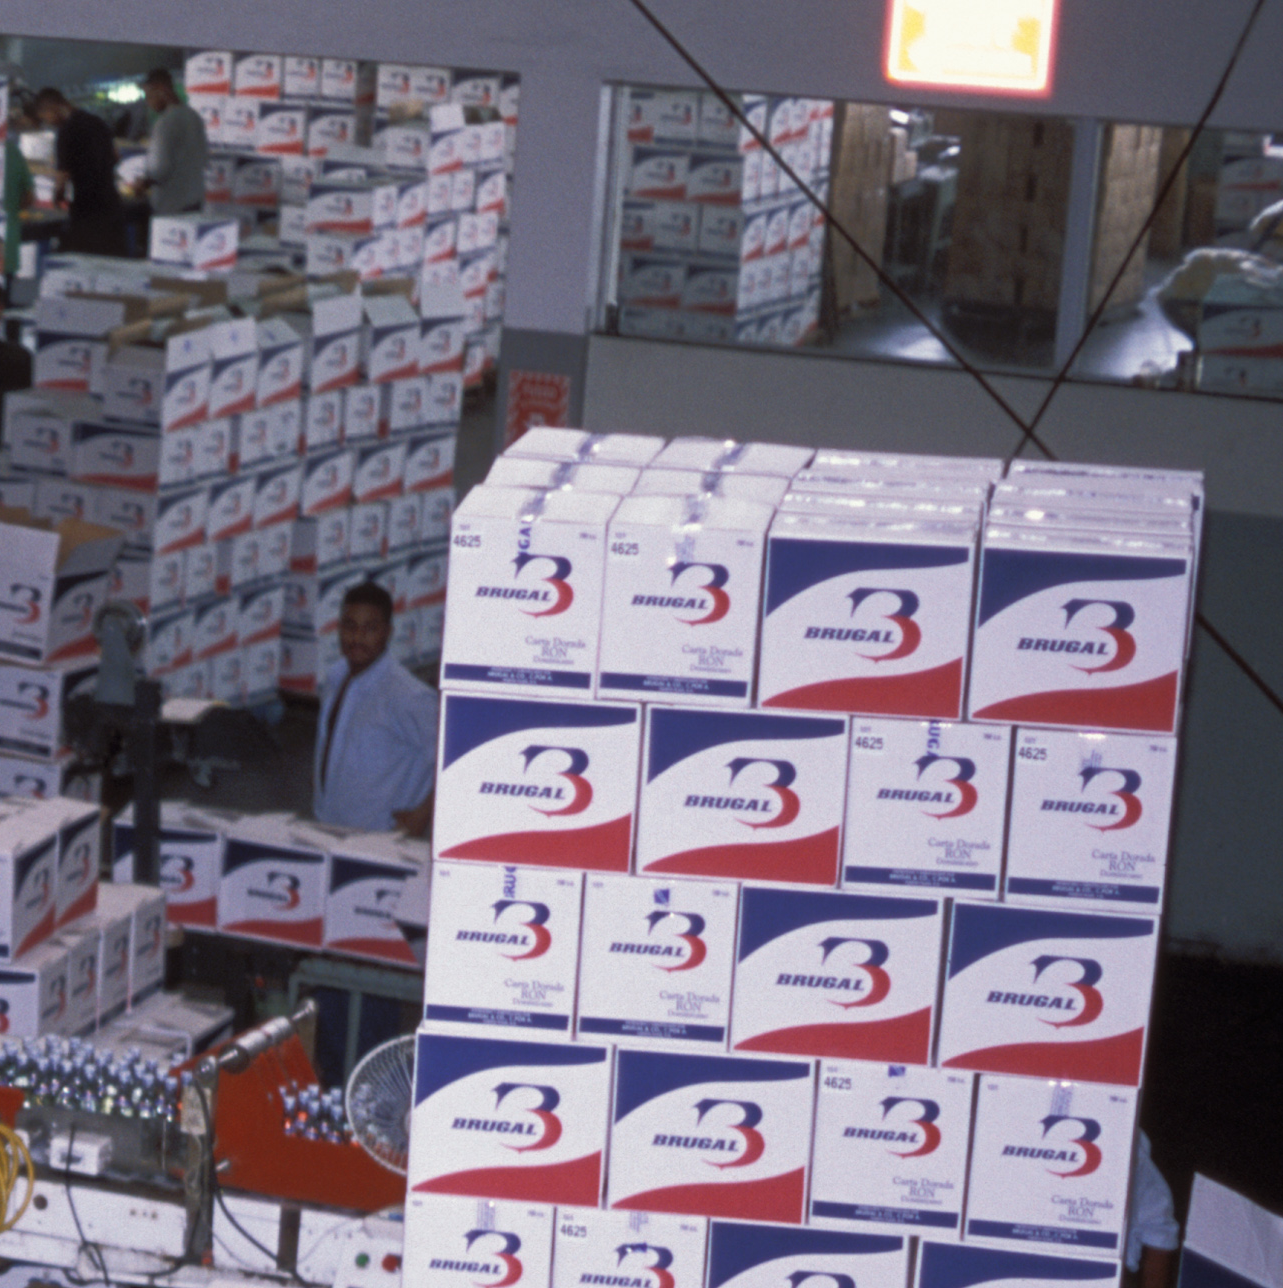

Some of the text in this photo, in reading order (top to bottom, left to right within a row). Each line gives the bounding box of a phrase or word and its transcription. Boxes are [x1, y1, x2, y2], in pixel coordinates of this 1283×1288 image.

[453, 535, 481, 548] 4625
[611, 542, 639, 555] 4625
[475, 586, 551, 601] BRUGAL
[631, 594, 707, 610] BRUGAL
[525, 635, 586, 648] Carta Dorada
[804, 626, 894, 644] BRUGAL
[542, 647, 567, 657] RON
[681, 644, 742, 656] Carta Dorada
[1017, 638, 1109, 656] BRUGAL
[698, 656, 723, 665] RON
[855, 736, 883, 750] 4625
[1018, 748, 1047, 761] 4625
[479, 782, 567, 800] BRUGAL
[877, 788, 954, 803] BRUGAL
[684, 795, 773, 812] BRUGAL
[1040, 799, 1119, 815] BRUGAL
[928, 837, 990, 849] Carta Dorada
[945, 849, 971, 858] RON
[1092, 849, 1154, 862] Carta Dorada
[1109, 861, 1135, 871] RON
[456, 930, 529, 946] BRUGAL
[609, 942, 684, 957] BRUGAL
[505, 978, 528, 989] Carta
[776, 973, 864, 991] BRUGAL
[659, 990, 683, 1000] Carta
[986, 990, 1076, 1011] BRUGAL
[824, 1077, 852, 1090] 4625
[451, 1117, 537, 1136] BRUGAL
[843, 1127, 918, 1143] BRUGAL
[652, 1134, 739, 1152] BRUGAL
[1002, 1145, 1079, 1162] BRUGAL
[893, 1175, 917, 1186] Carta
[1051, 1194, 1076, 1206] Carta
[560, 1224, 588, 1238] 4625
[429, 1258, 501, 1274] BRUGAL
[580, 1273, 653, 1288] BRUGAL
